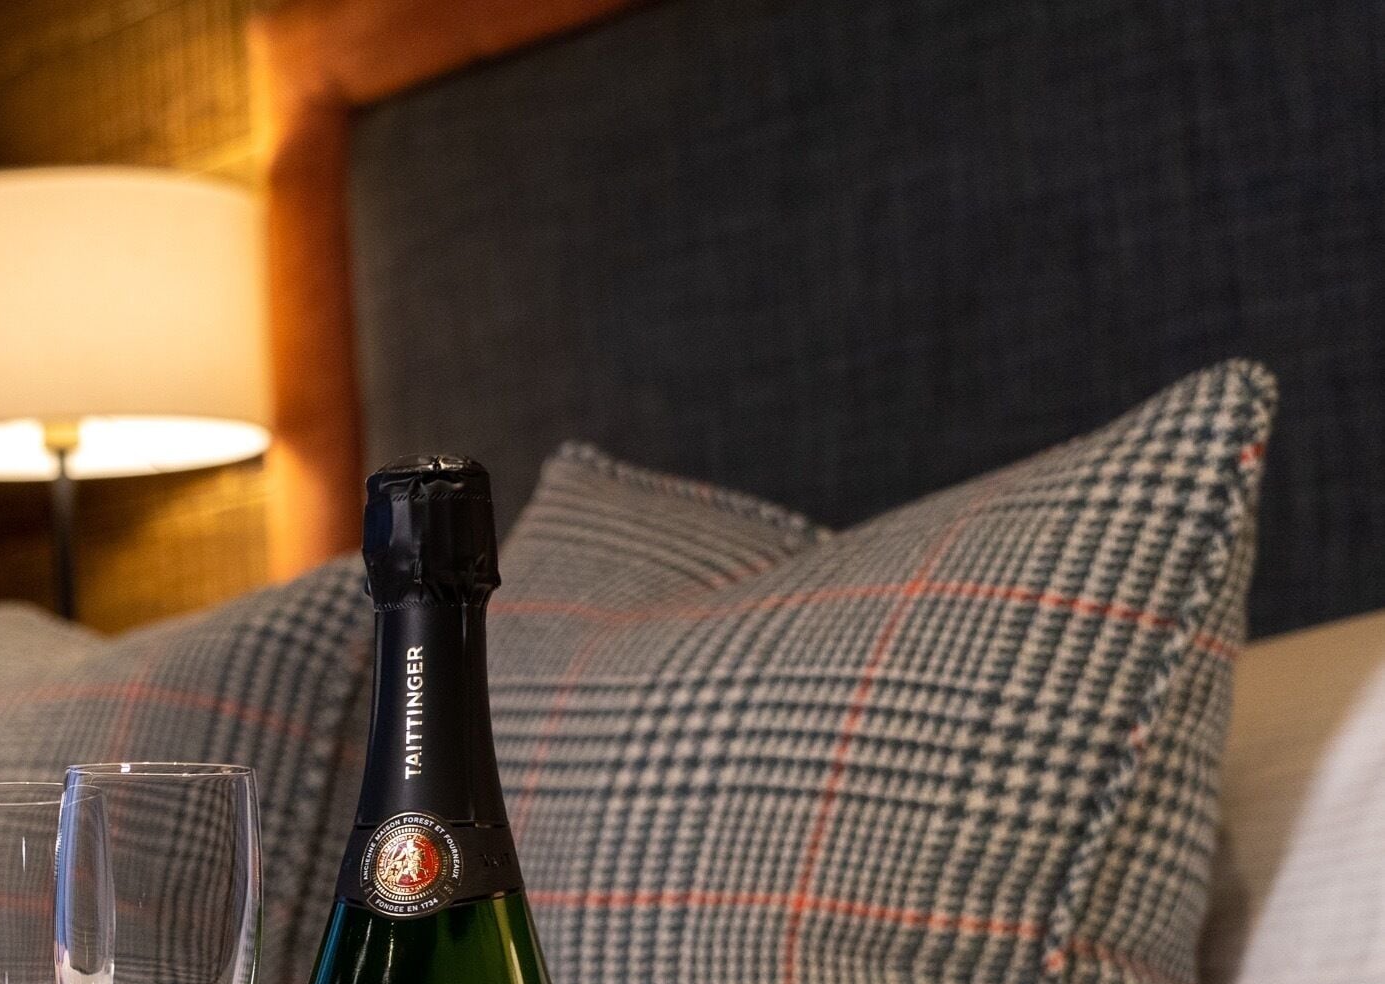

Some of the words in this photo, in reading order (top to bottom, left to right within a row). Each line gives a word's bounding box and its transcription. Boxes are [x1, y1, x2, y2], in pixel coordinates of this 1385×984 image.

[405, 645, 423, 780] TAITTINGER
[363, 841, 376, 880] ANCIENNE
[374, 819, 401, 841] MAISON
[403, 816, 434, 827] FOREST
[434, 825, 446, 835] ET
[443, 833, 461, 880] FOURNEAUX
[407, 904, 419, 913] EN
[421, 898, 439, 910] 1734
